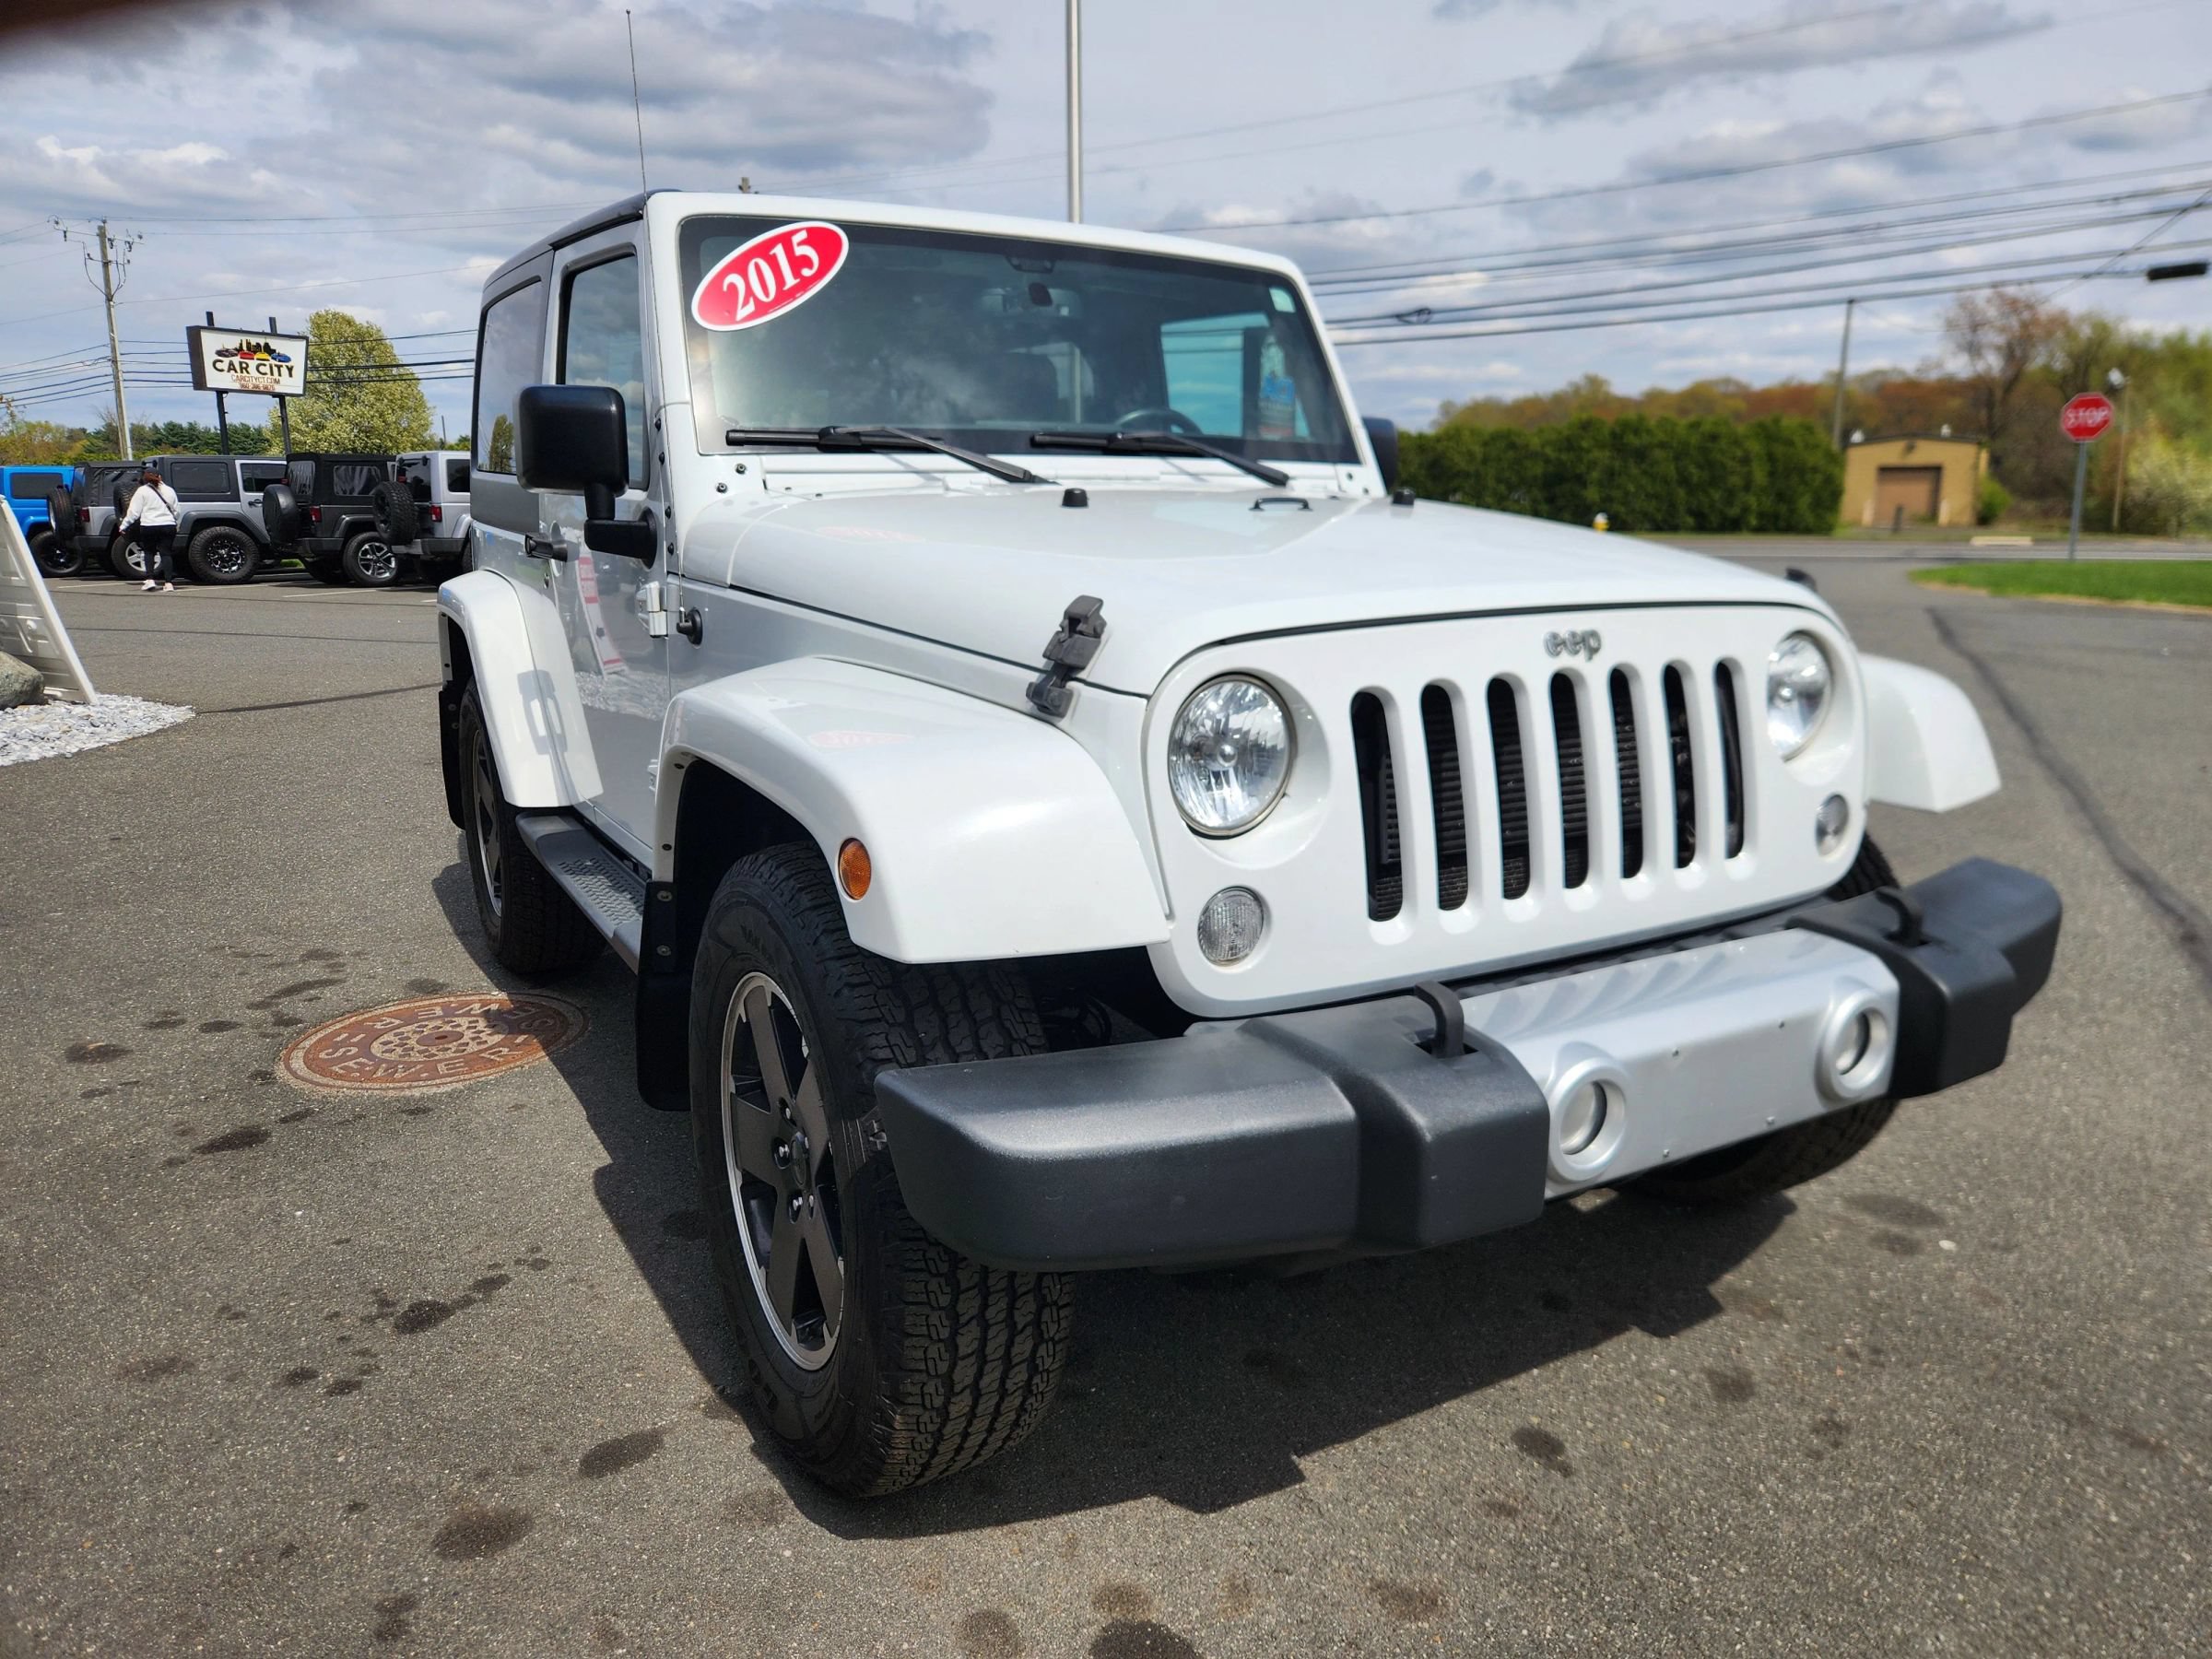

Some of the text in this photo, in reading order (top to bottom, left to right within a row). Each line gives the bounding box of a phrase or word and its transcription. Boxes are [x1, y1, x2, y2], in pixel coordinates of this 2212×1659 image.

[723, 229, 819, 322] 2015
[212, 359, 294, 378] CAR CITY
[231, 374, 280, 385] CARCITYCT.COM
[2065, 406, 2110, 429] STOP
[319, 1046, 524, 1079] SEWER
